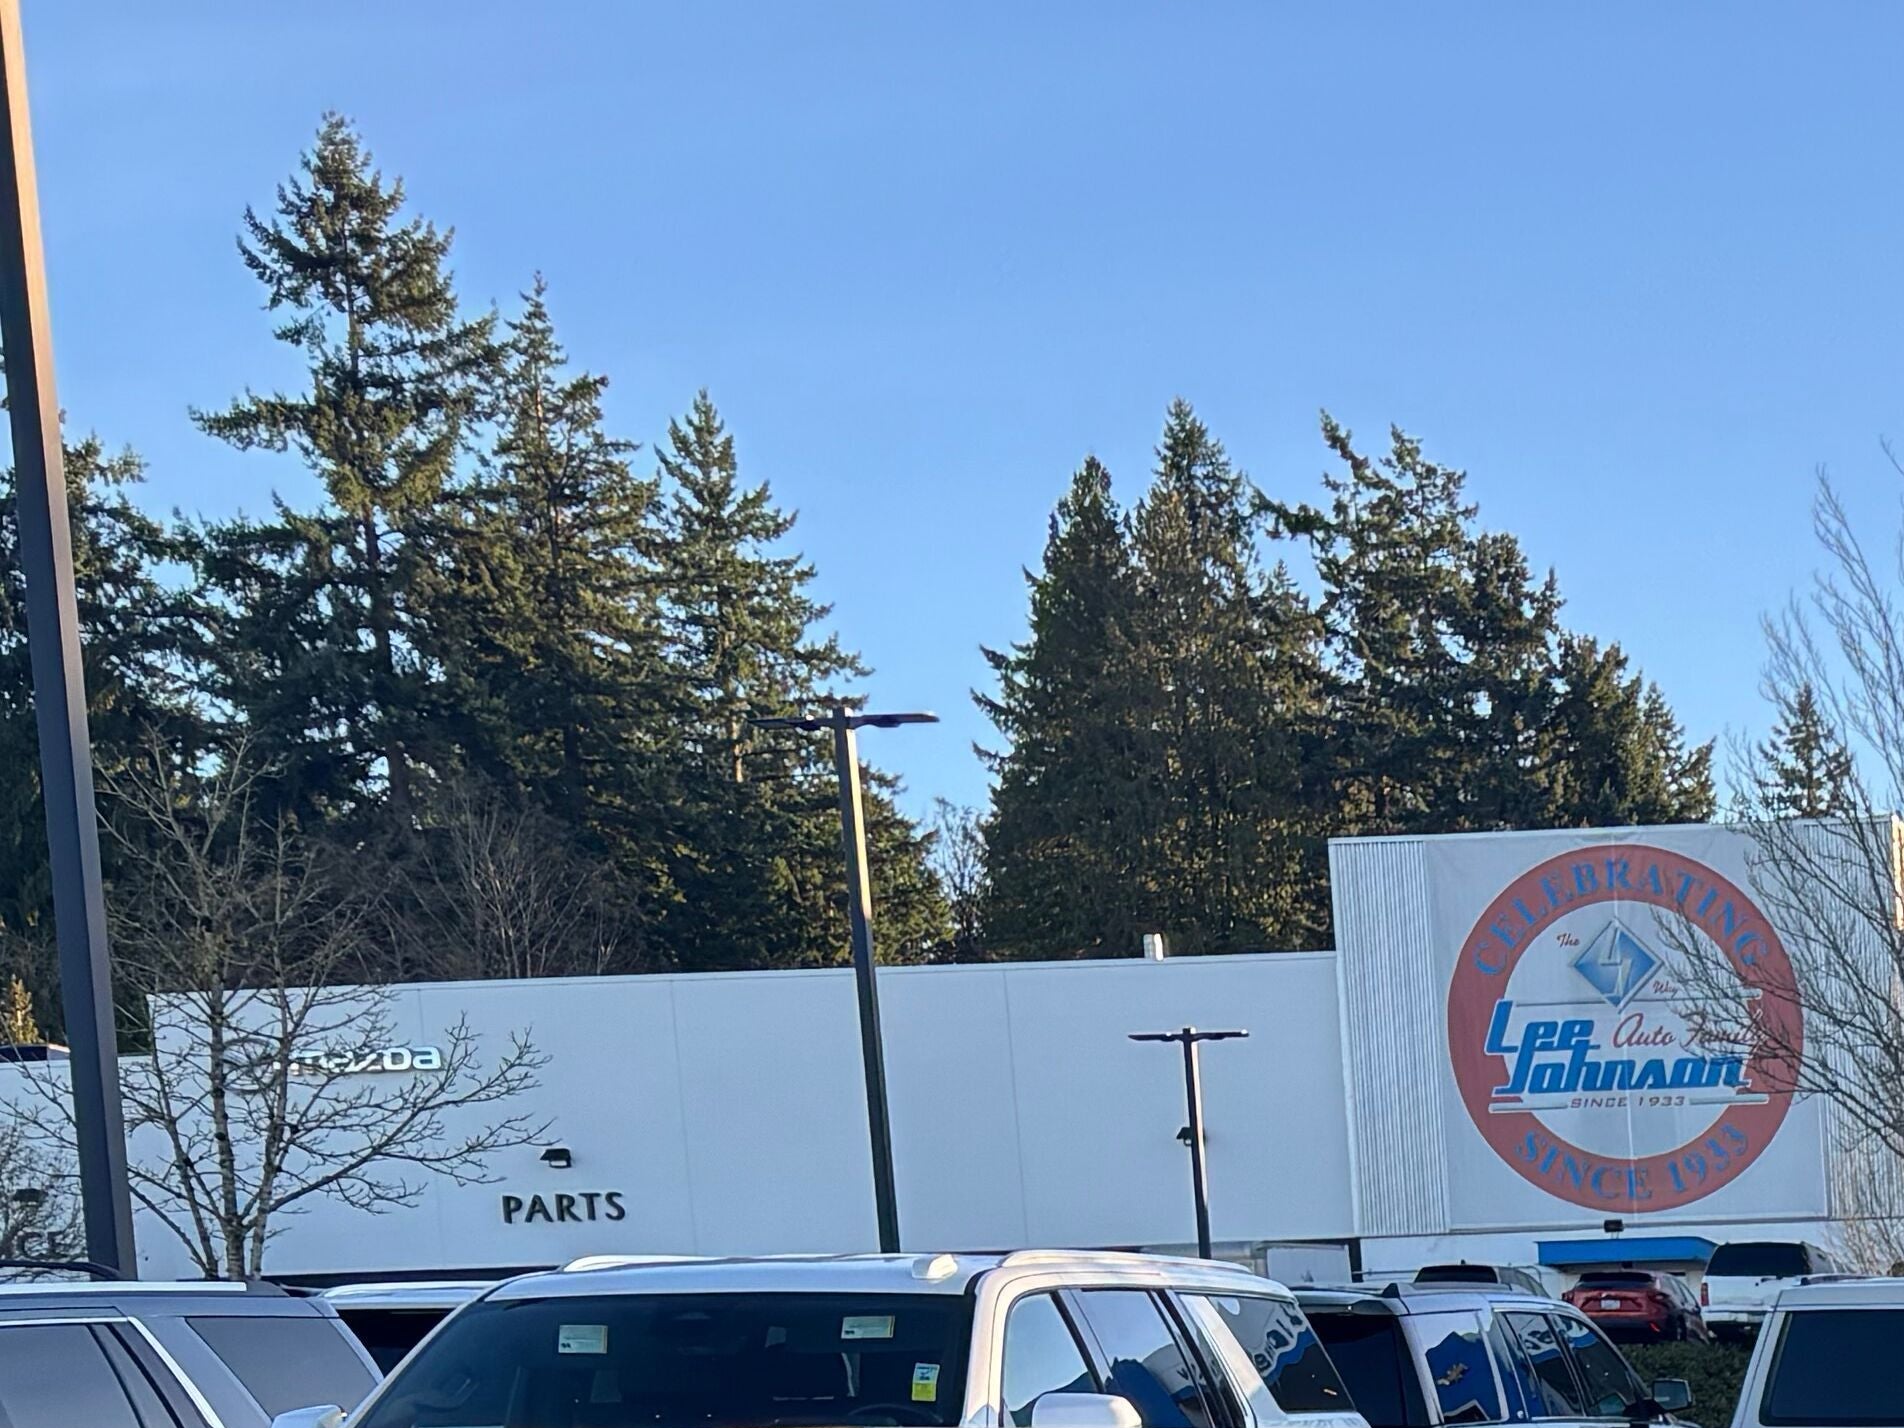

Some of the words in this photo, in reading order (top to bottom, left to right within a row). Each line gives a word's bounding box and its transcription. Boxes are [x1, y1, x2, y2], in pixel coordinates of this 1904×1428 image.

[1473, 857, 1771, 976] CELEBRATING
[1557, 933, 1580, 947] The
[1486, 1000, 1600, 1053] Lee
[1613, 1013, 1676, 1048] Auto
[1494, 1048, 1751, 1095] Johnson
[1570, 1096, 1627, 1109] SINCE
[1639, 1096, 1685, 1107] 1933
[1516, 1130, 1651, 1200] SINCE
[1668, 1123, 1750, 1193] 1933
[502, 1192, 626, 1224] PARTS
